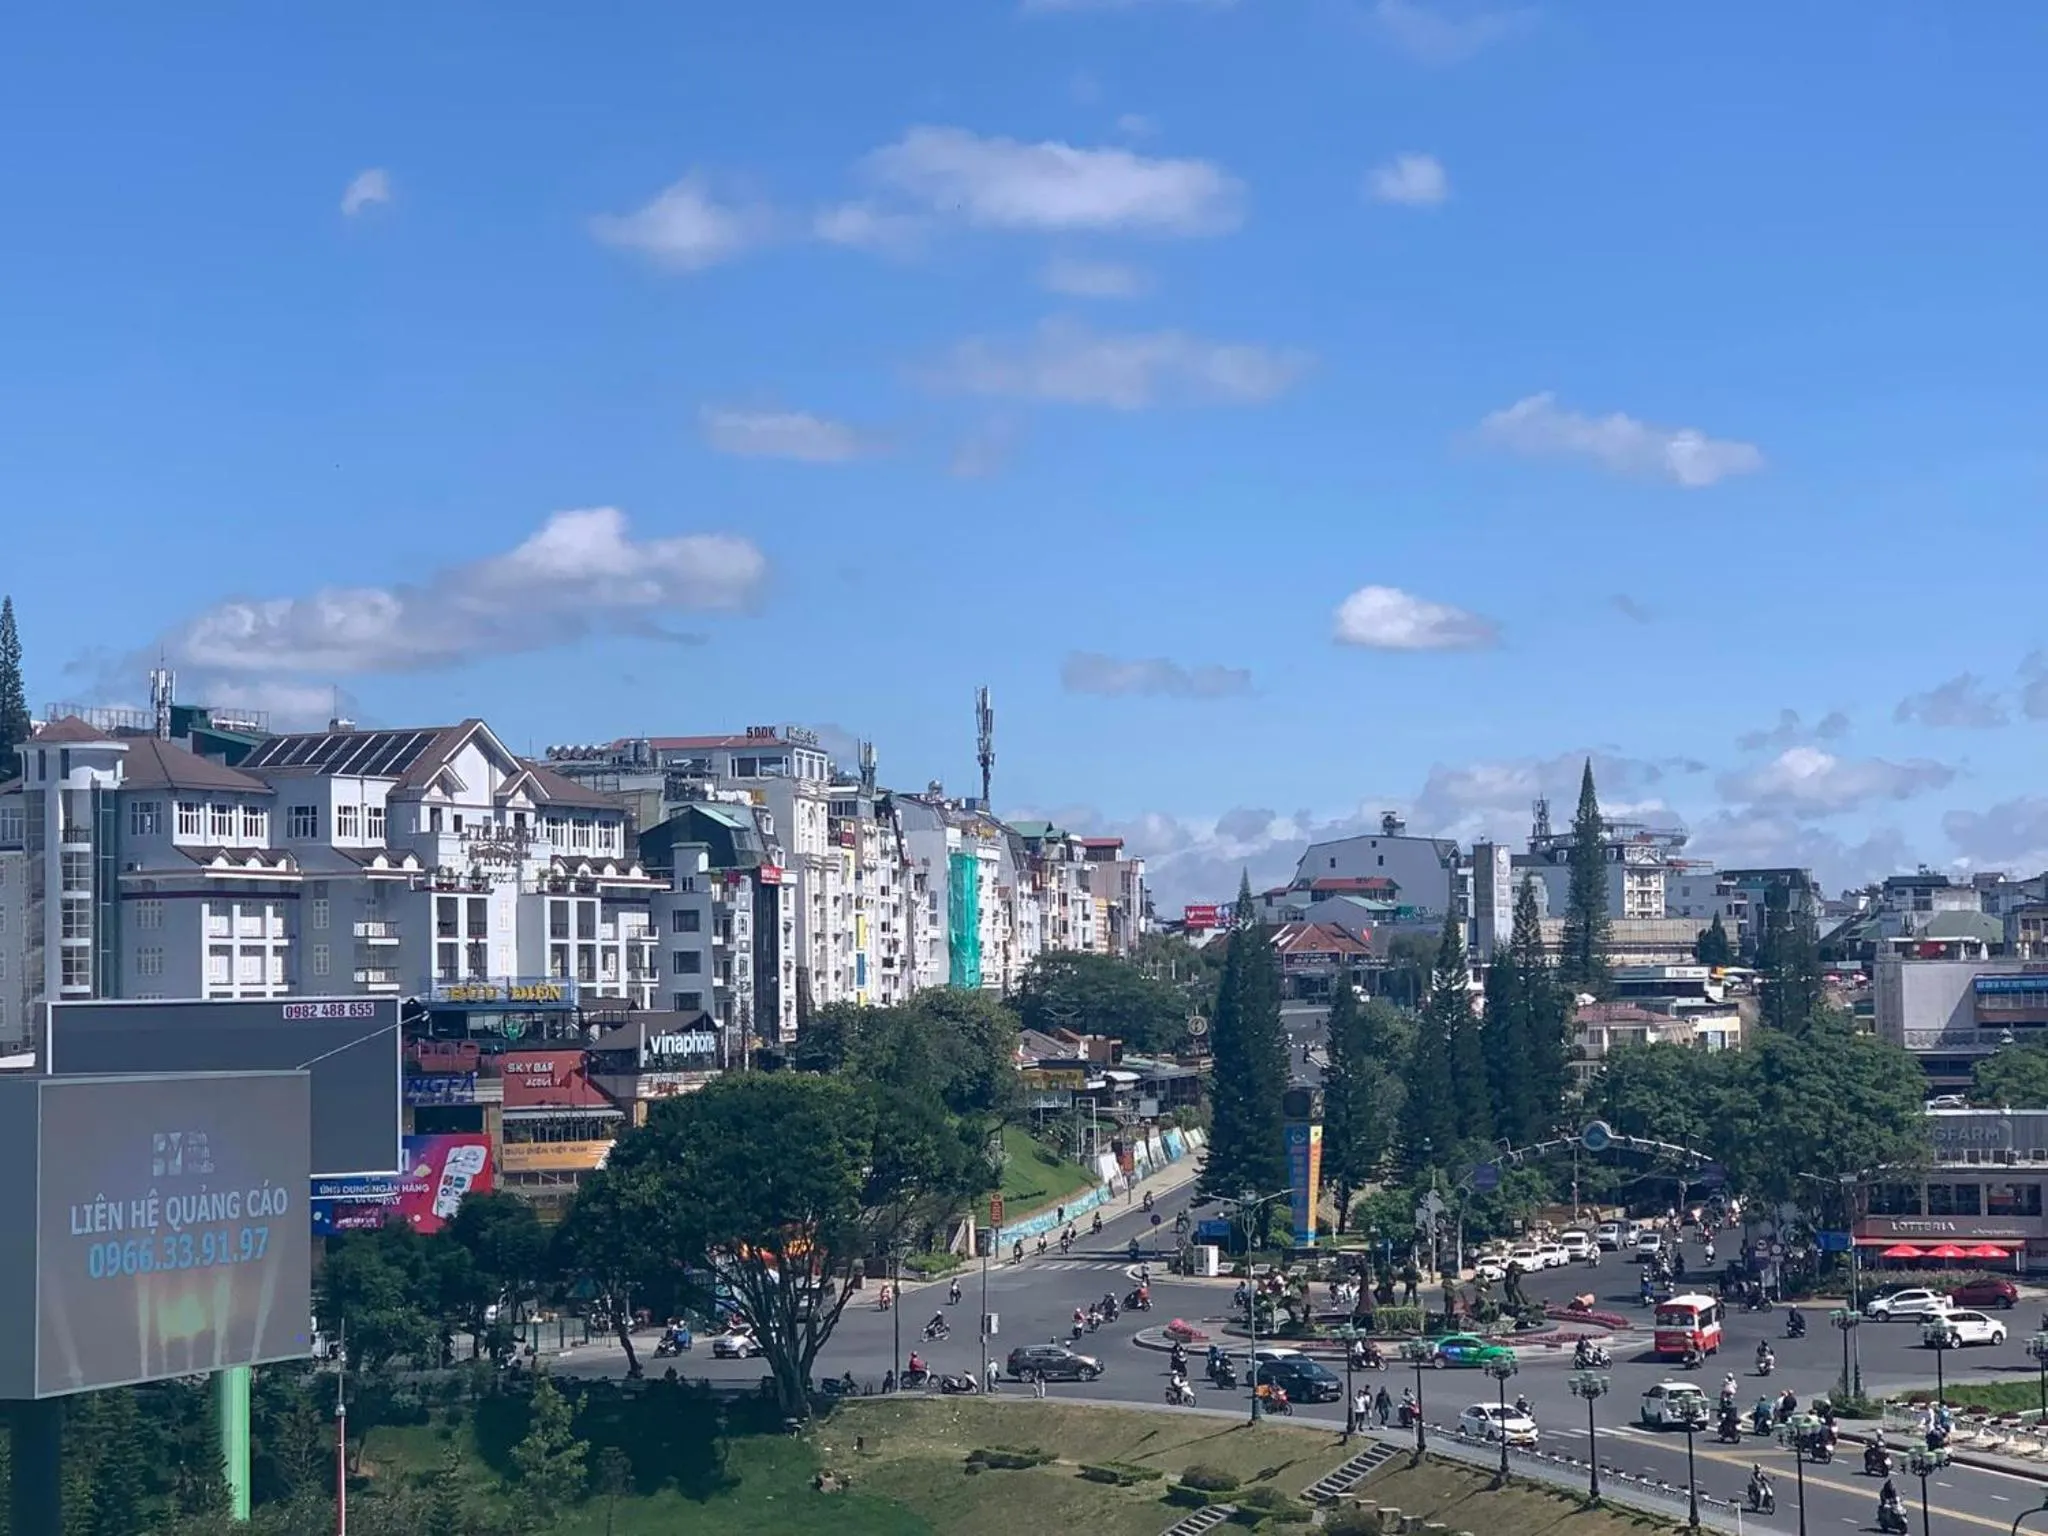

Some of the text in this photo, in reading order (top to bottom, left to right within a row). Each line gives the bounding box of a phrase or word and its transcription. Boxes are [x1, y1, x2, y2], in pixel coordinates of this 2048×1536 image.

[746, 726, 776, 738] 500K
[285, 1003, 372, 1018] 0982 488 655
[650, 1029, 716, 1057] vinaphone
[71, 1179, 288, 1235] LIÊN HỆ QUẢNG CÁO
[1891, 1221, 1956, 1231] LOTTERIA
[89, 1226, 269, 1279] 0966.33.91.97
